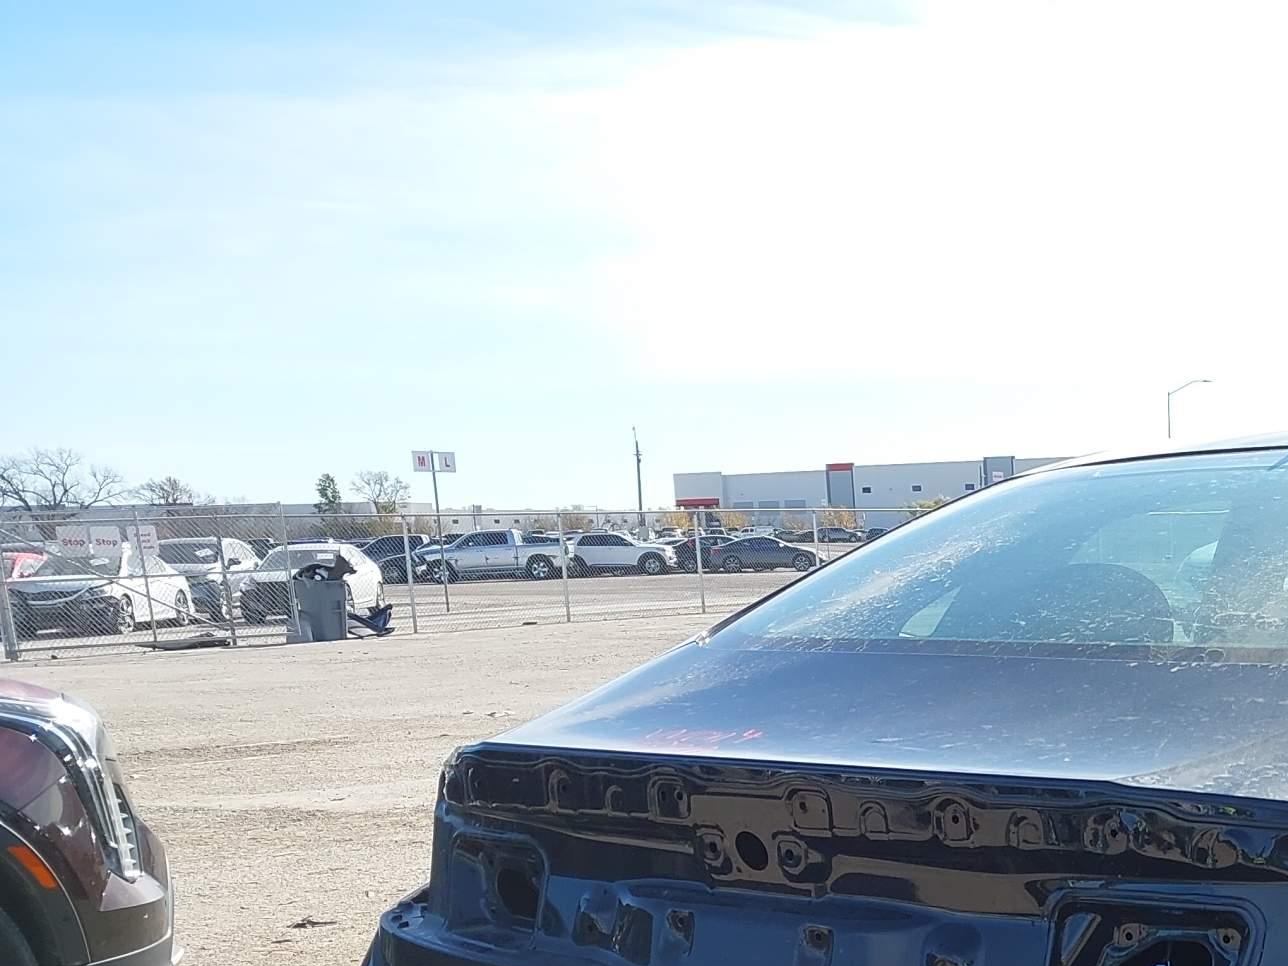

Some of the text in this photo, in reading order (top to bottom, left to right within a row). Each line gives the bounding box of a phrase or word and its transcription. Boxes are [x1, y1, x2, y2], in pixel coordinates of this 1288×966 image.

[417, 455, 426, 467] M
[444, 456, 451, 468] L
[62, 538, 86, 547] Stop
[95, 538, 118, 547] Stop
